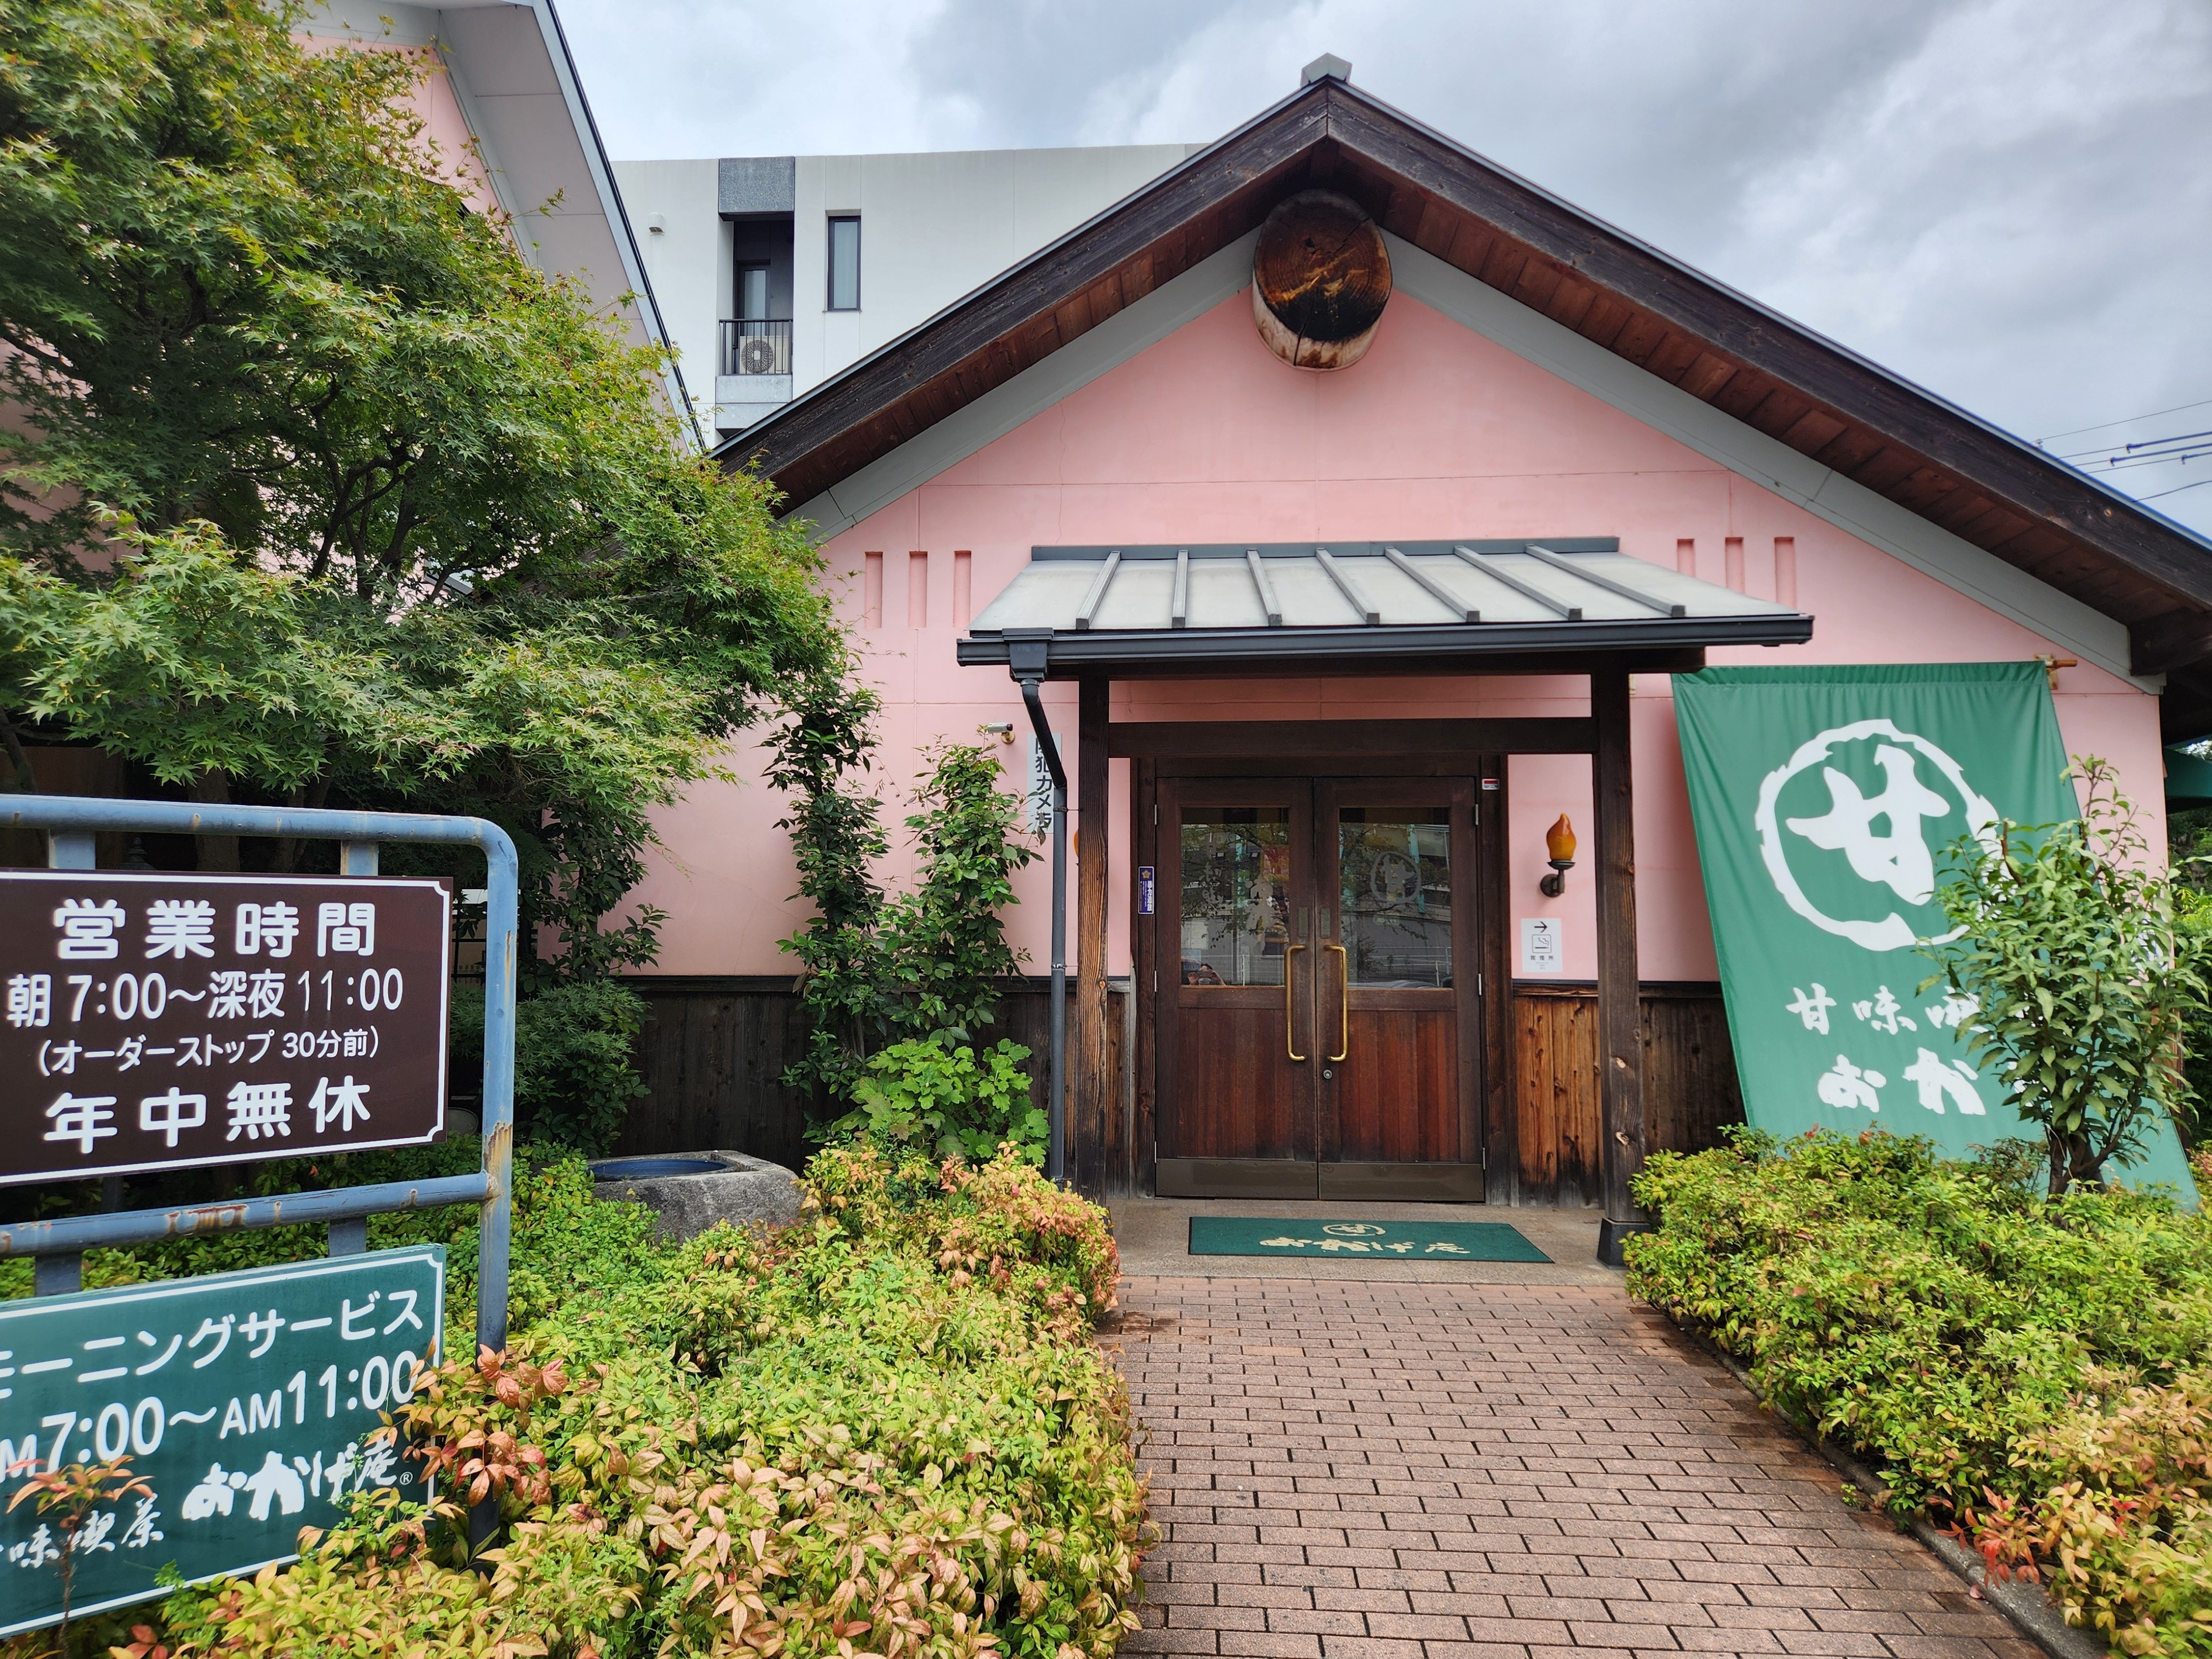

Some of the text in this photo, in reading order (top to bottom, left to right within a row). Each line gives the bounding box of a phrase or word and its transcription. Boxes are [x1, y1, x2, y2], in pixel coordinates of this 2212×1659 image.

[1035, 737, 1053, 829] 犯カメラ
[54, 898, 376, 960] 営業時間
[43, 1074, 371, 1154] 年中無休
[0, 1493, 164, 1568] 味喫茶
